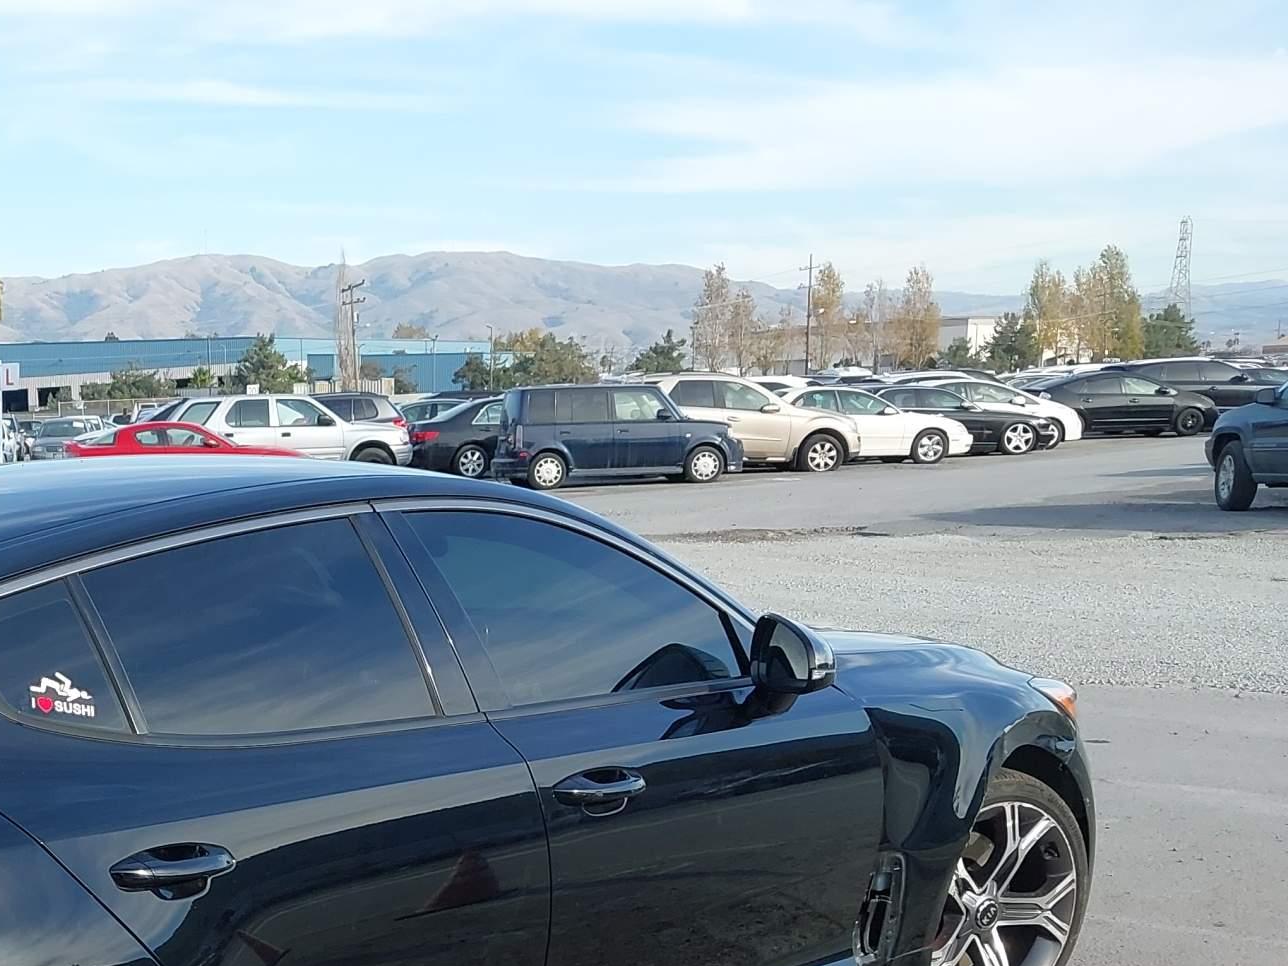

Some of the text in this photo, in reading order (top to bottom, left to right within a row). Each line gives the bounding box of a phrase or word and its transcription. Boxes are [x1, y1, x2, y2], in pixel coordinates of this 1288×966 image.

[31, 697, 95, 717] I SUSHI
[981, 906, 997, 925] KIA
